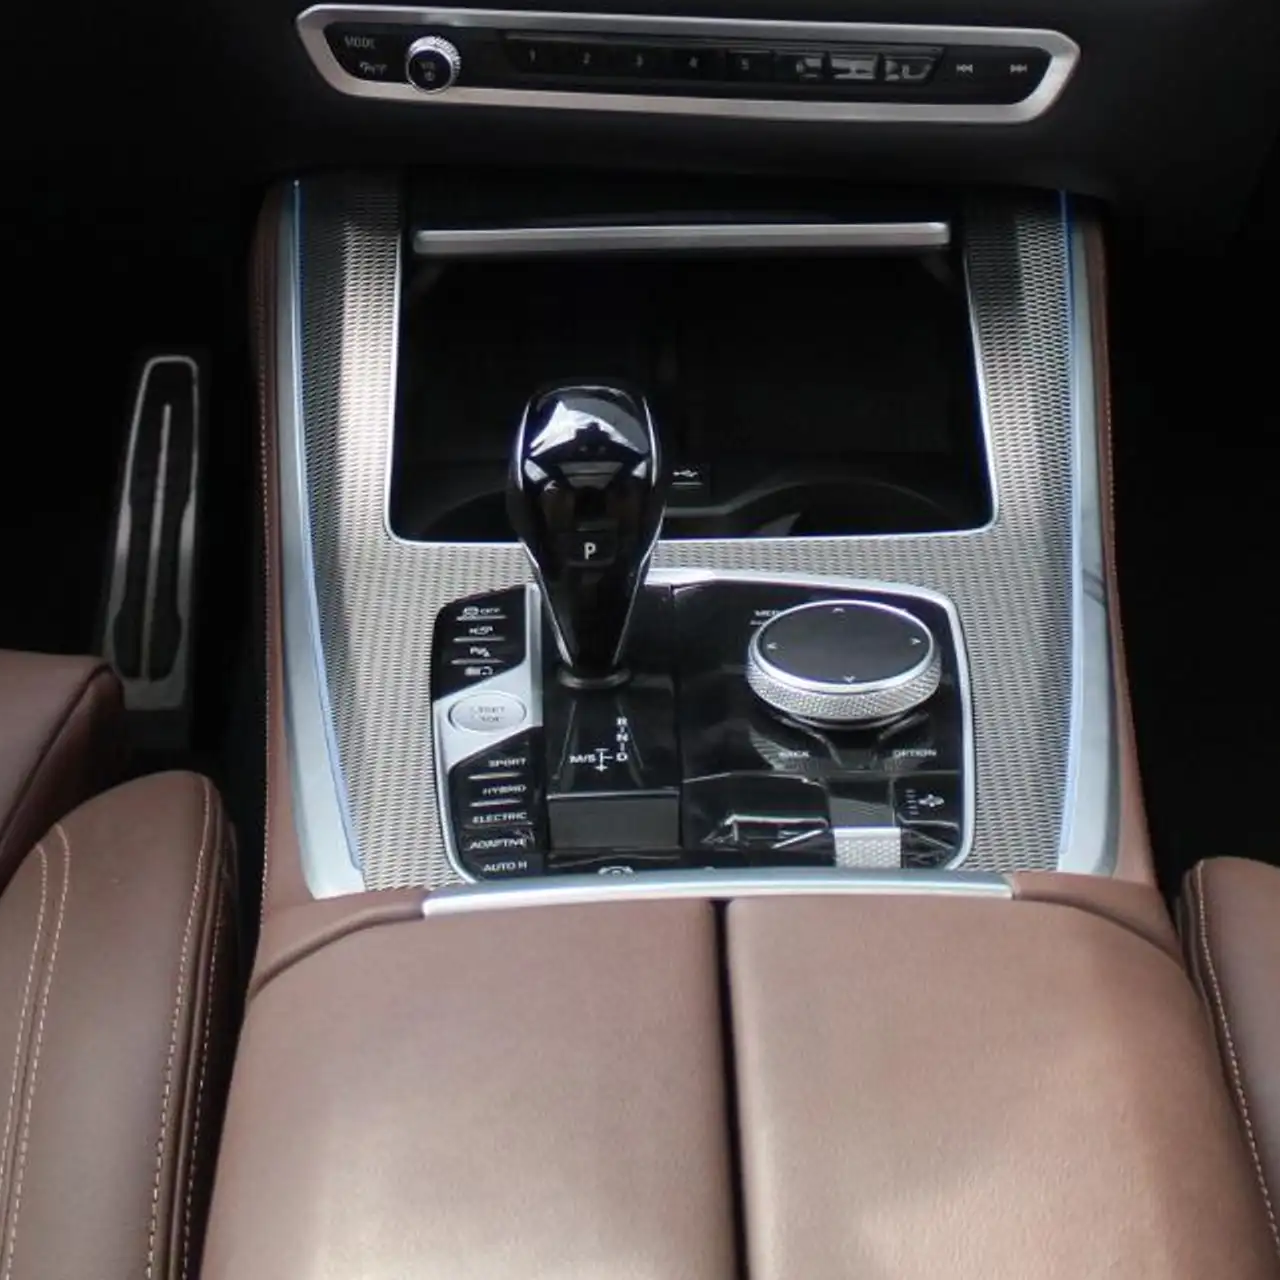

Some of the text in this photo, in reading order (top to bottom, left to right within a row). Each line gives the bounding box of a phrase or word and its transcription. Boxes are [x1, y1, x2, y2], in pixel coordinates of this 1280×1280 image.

[583, 541, 596, 559] P
[472, 811, 528, 824] ELECTRIC
[483, 861, 516, 872] AUTO
